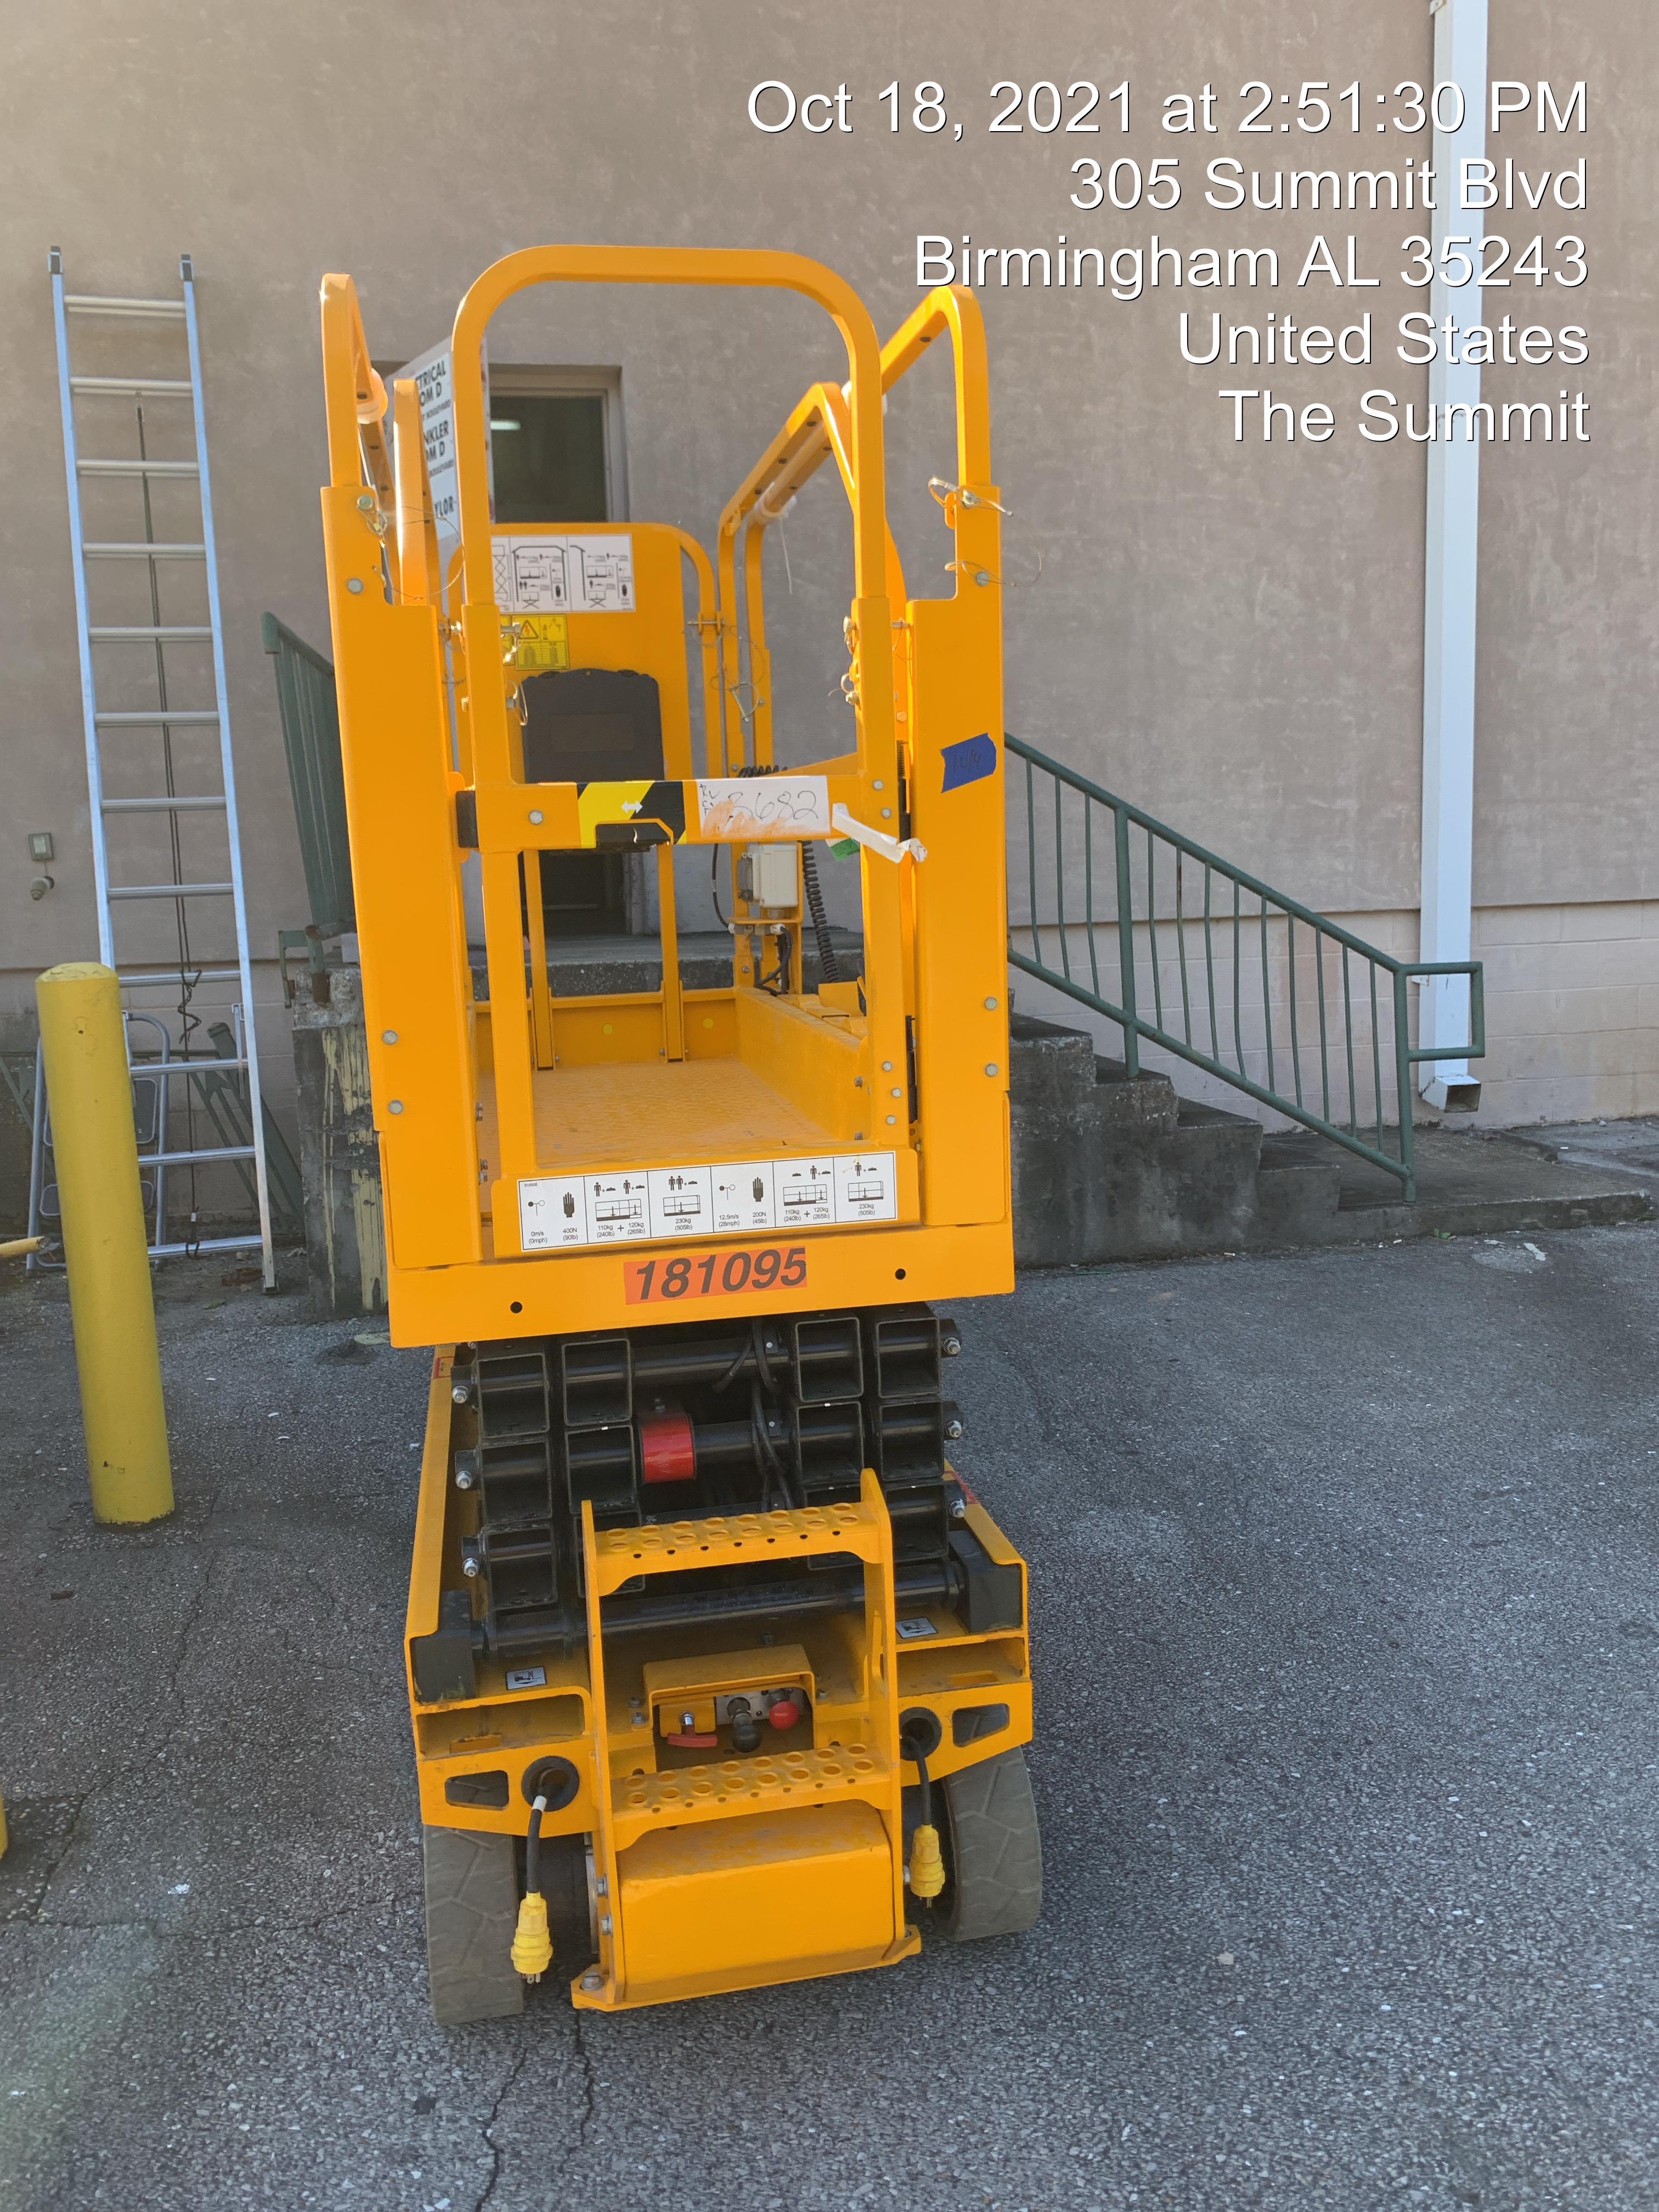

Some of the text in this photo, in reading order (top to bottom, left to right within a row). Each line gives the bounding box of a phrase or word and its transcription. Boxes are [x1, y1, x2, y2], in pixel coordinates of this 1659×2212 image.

[415, 360, 447, 390] TRICAL
[420, 386, 434, 406] OM
[424, 420, 449, 445] NKLER
[435, 496, 454, 516] YLOR
[636, 1246, 806, 1300] 181095
